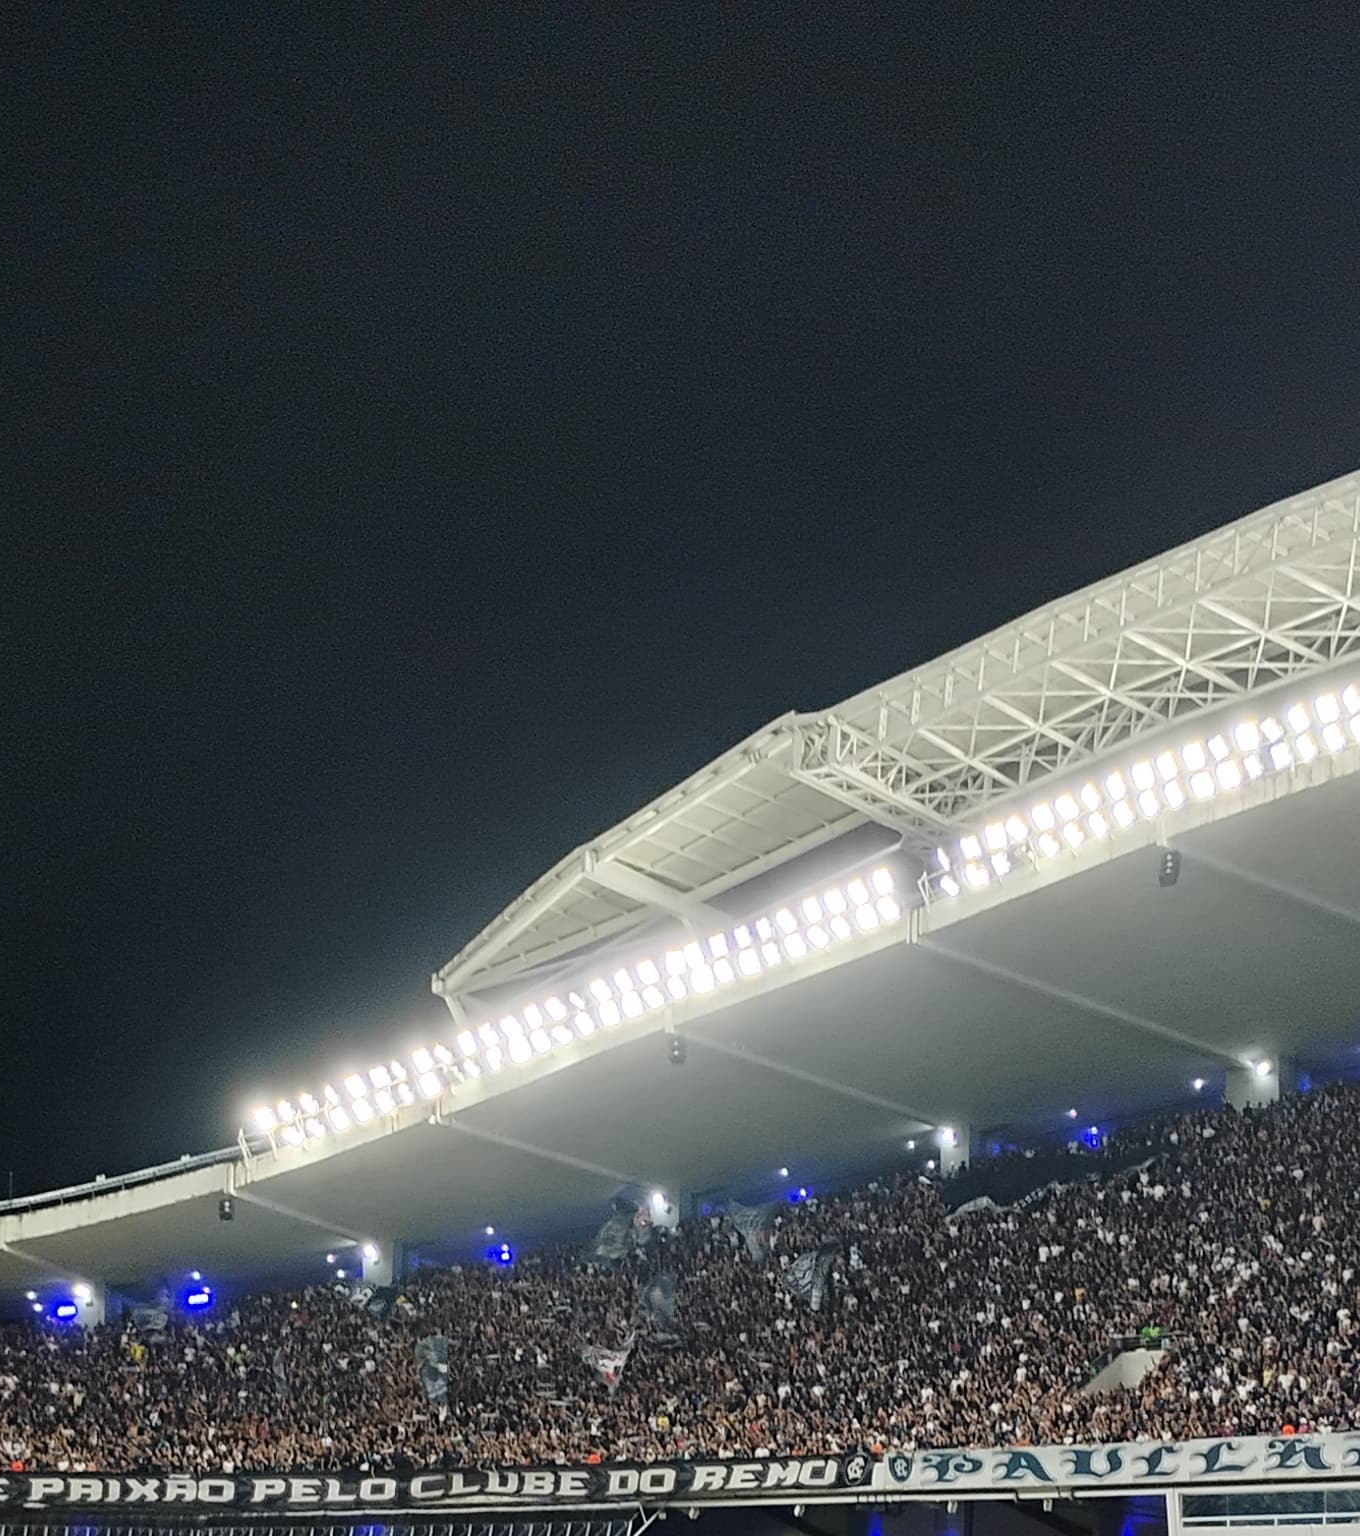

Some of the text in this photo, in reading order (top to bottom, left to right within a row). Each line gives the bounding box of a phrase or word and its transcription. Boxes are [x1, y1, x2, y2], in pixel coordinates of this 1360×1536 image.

[26, 1473, 236, 1503] PAIXÃO
[251, 1476, 397, 1502] PELO
[410, 1471, 591, 1499] CLUBE
[606, 1467, 676, 1495] DO
